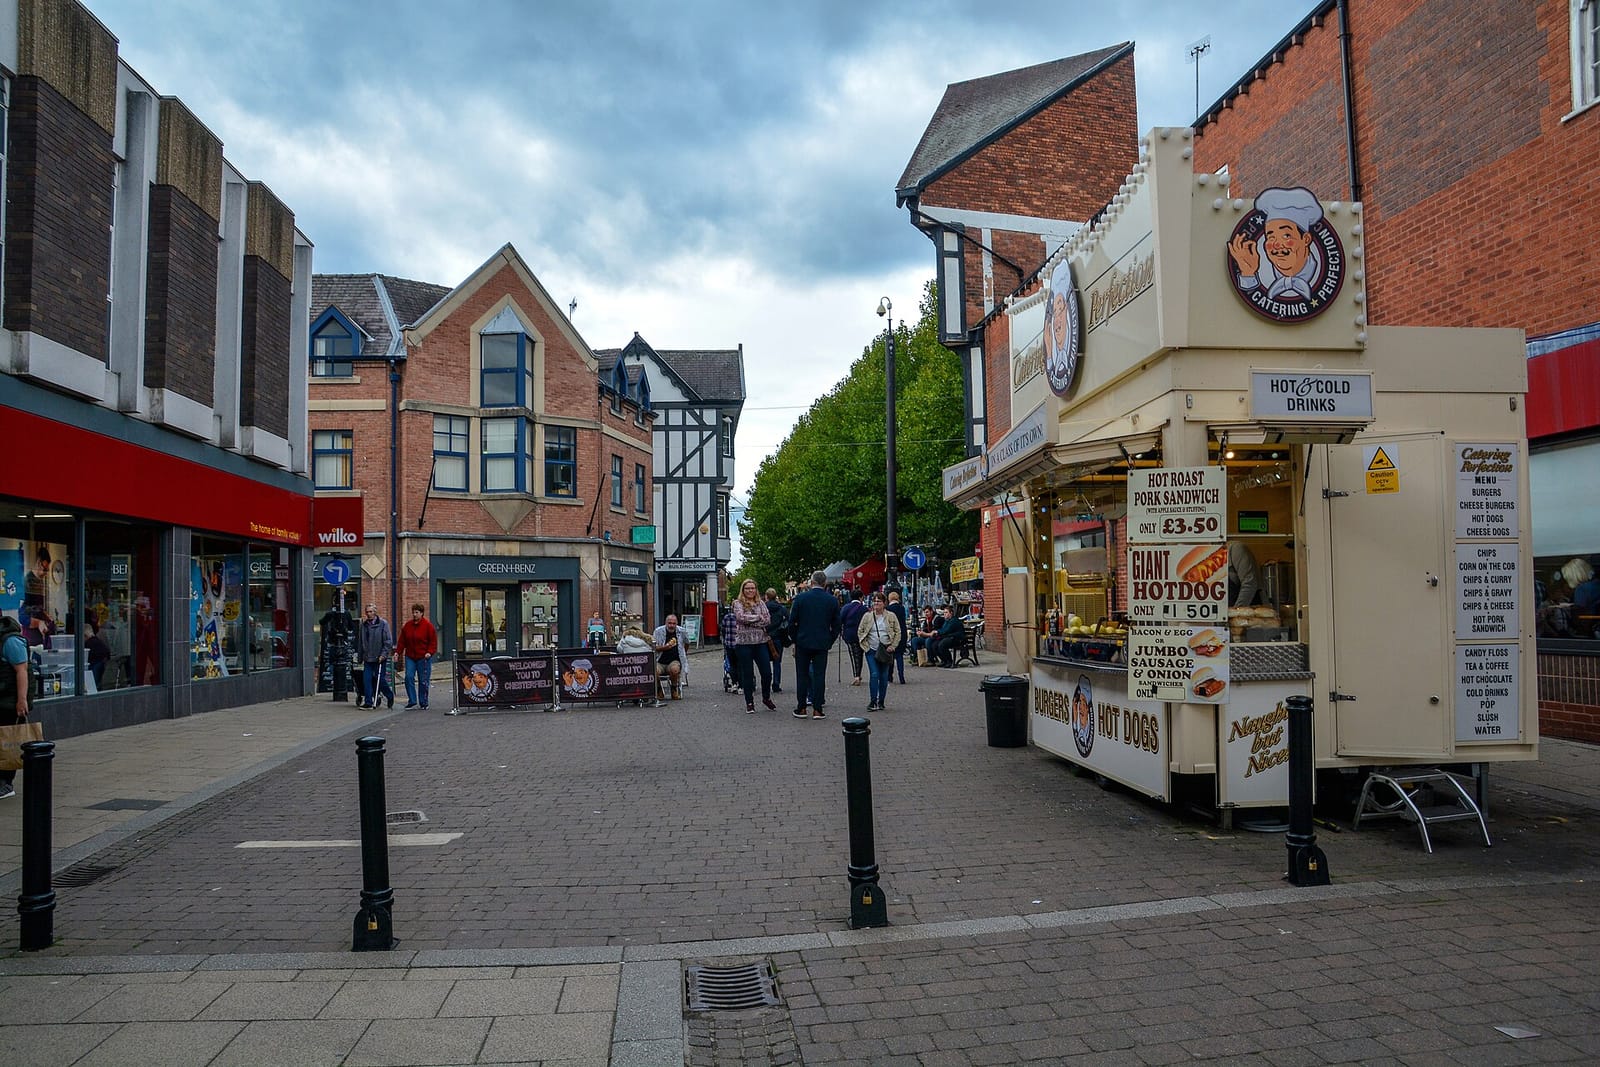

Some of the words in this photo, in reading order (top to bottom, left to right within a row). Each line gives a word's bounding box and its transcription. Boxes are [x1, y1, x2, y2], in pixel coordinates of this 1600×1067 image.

[1252, 290, 1308, 316] CATERING
[1318, 229, 1340, 301] PERFECTION
[1014, 338, 1045, 389] Catering
[1088, 251, 1154, 330] Perfection
[1050, 371, 1068, 390] CATERING
[1270, 380, 1297, 393] HOT
[1296, 378, 1318, 397] &
[1316, 380, 1350, 394] COLD
[1287, 398, 1336, 412] DRINKS
[1000, 444, 1013, 462] CLASS
[1014, 438, 1020, 454] OF
[1461, 448, 1512, 463] Catering
[1460, 460, 1513, 475] Perfection
[1148, 473, 1168, 488] HOT
[1171, 471, 1204, 486] ROAST
[1475, 476, 1496, 484] MENU
[1472, 488, 1501, 496] BURGERS
[1134, 491, 1161, 506] PORK
[1163, 489, 1219, 505] SANDWICH
[1140, 523, 1157, 534] ONLY
[1163, 517, 1218, 534] £3.50
[318, 528, 357, 543] wilko
[1467, 528, 1491, 536] CHEESE
[1493, 528, 1510, 536] DOGS
[1478, 549, 1496, 557] CHIPS
[1132, 551, 1170, 580] GIANT
[1459, 562, 1476, 570] CORN
[1478, 562, 1487, 570] ON
[1490, 562, 1501, 570] THE
[1503, 562, 1515, 570] COB
[1463, 576, 1482, 584] CHIPS
[1133, 582, 1226, 600] HOTDOG
[1464, 589, 1482, 597] CHIPS
[1485, 589, 1489, 597] &
[1491, 589, 1512, 597] GRAVY
[1134, 606, 1155, 616] ONLY
[1463, 602, 1482, 610] CHIPS
[1484, 602, 1488, 610] &
[1491, 602, 1514, 610] CHEESE
[1472, 624, 1506, 632] SANDWICH
[1135, 646, 1188, 656] JUMBO
[1465, 649, 1487, 657] CANDY
[509, 660, 546, 670] WELCOMES
[610, 656, 648, 666] WELCOMES
[1131, 658, 1194, 668] SAUSAGE
[1465, 662, 1477, 670] TEA
[1479, 662, 1483, 670] &
[1486, 662, 1509, 670] COFFEE
[516, 671, 530, 679] YOU
[531, 671, 540, 679] TO
[617, 666, 631, 675] YOU
[632, 666, 642, 674] TO
[1133, 669, 1143, 678] &
[1147, 670, 1192, 680] ONION
[606, 675, 654, 686] CHESTERFIELD
[1462, 676, 1474, 684] HOT
[1476, 675, 1512, 683] CHOCOLATE
[505, 680, 552, 690] CHESTERFIELD
[1466, 689, 1483, 697] COLD
[1485, 688, 1508, 696] DRINKS
[1034, 688, 1069, 725] BURGERS
[1098, 702, 1120, 741] HOT
[1124, 707, 1159, 754] DOGS
[1475, 726, 1501, 734] WATER
[1251, 726, 1284, 754] but
